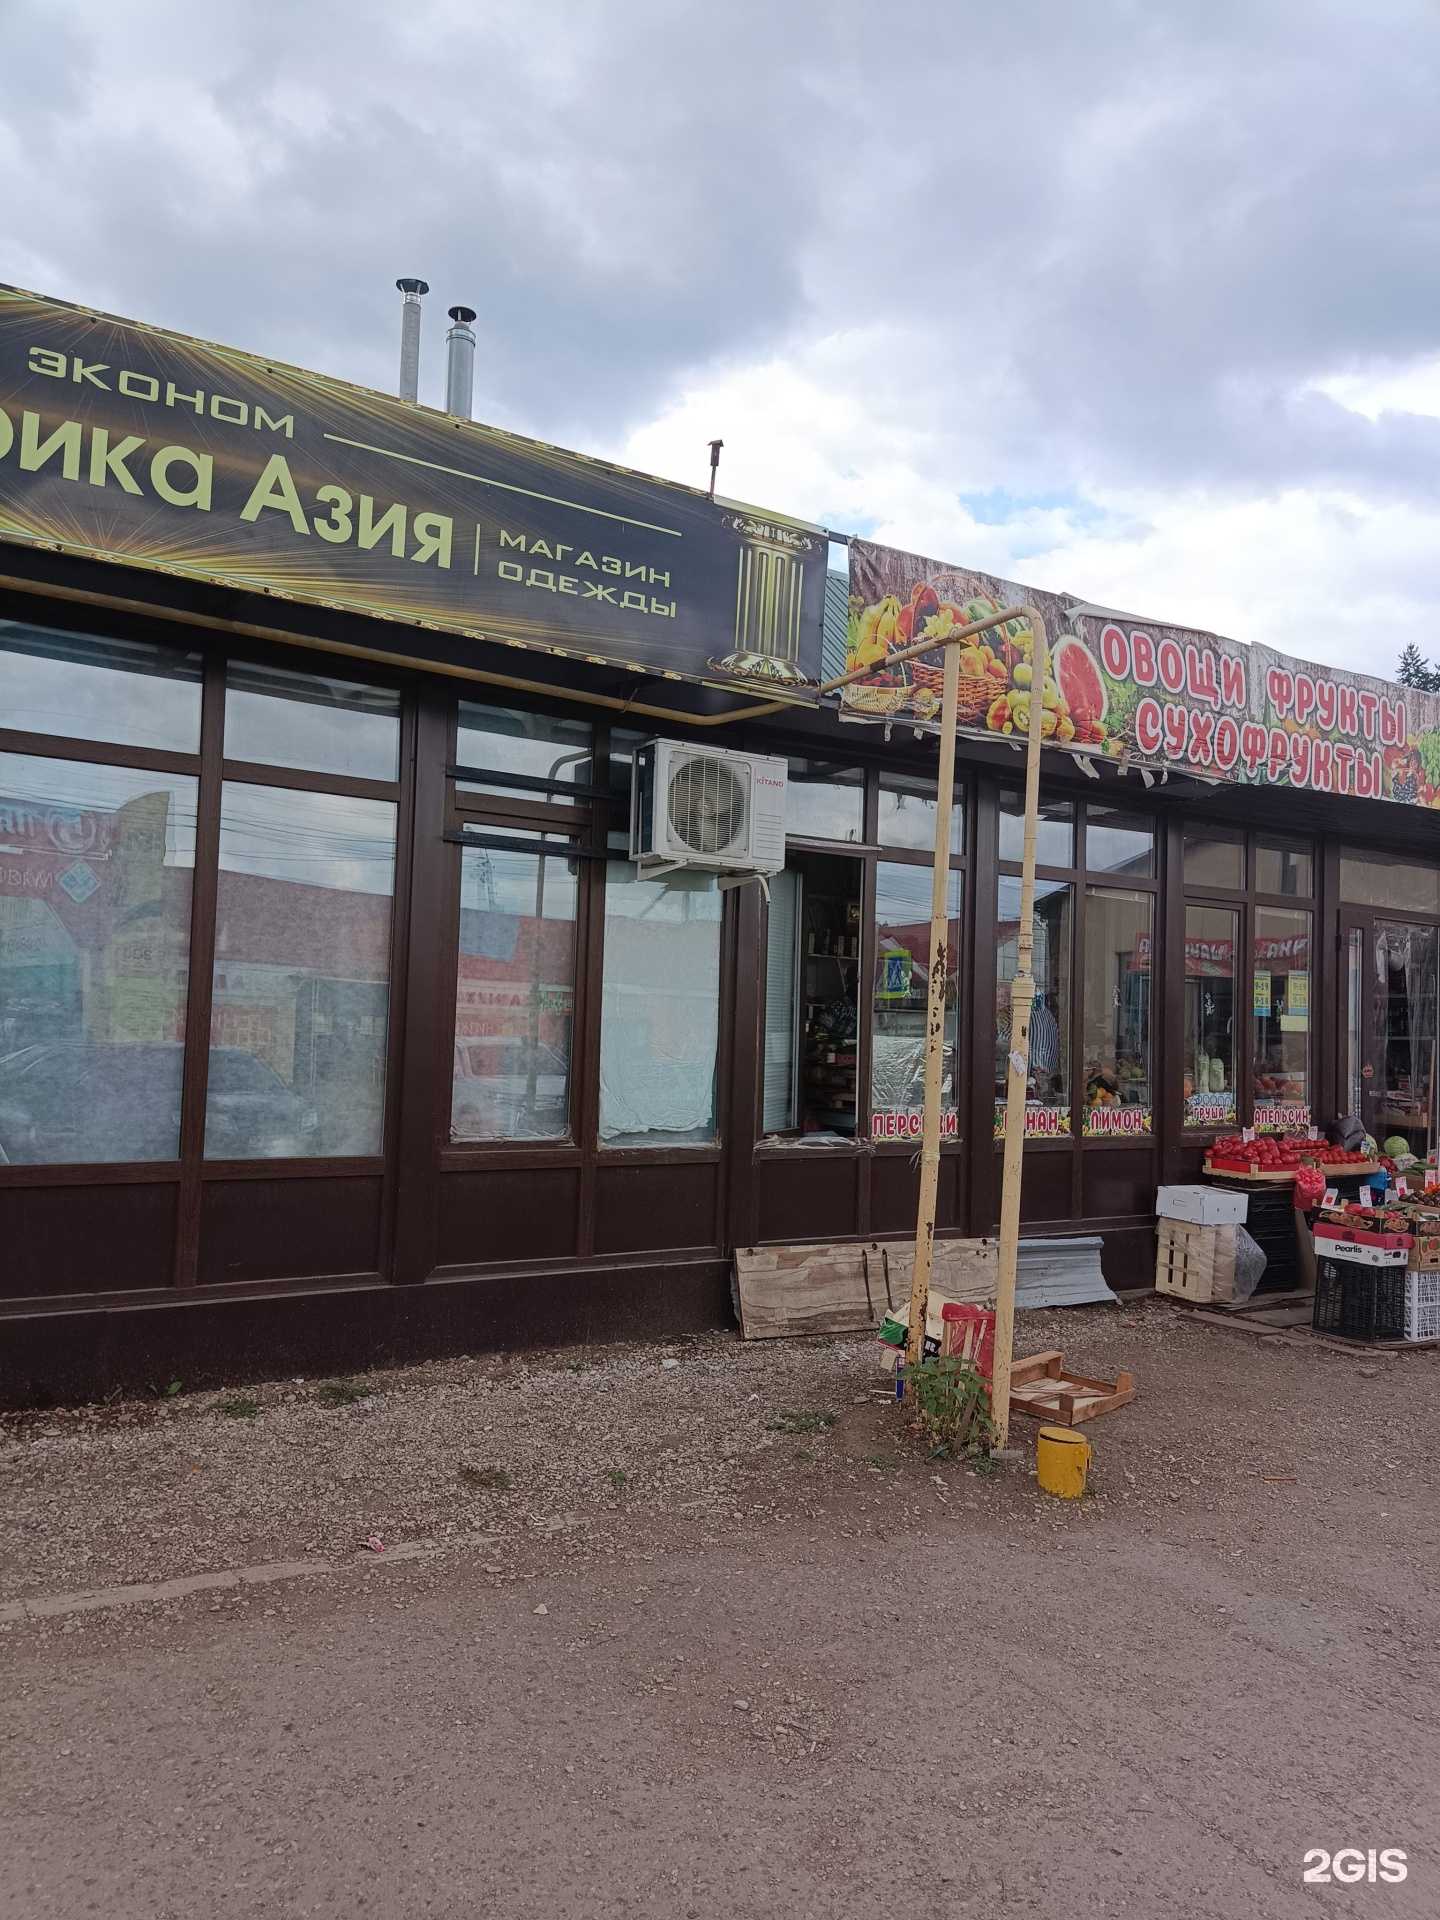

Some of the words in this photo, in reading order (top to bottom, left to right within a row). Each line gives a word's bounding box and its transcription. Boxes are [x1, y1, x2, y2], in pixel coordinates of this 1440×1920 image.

[0, 410, 214, 511] ика
[240, 454, 453, 568] Азия
[1100, 624, 1246, 707] ОВОЩИ
[1266, 665, 1406, 747] ФРУКТЫ
[1136, 698, 1384, 798] СУХОФРУКТЫ
[1090, 1108, 1142, 1131] ЛИМОН
[1193, 1106, 1225, 1120] ГРУША
[1253, 1107, 1310, 1125] АПЕЛЬСИН
[1335, 1244, 1362, 1254] Pearlis
